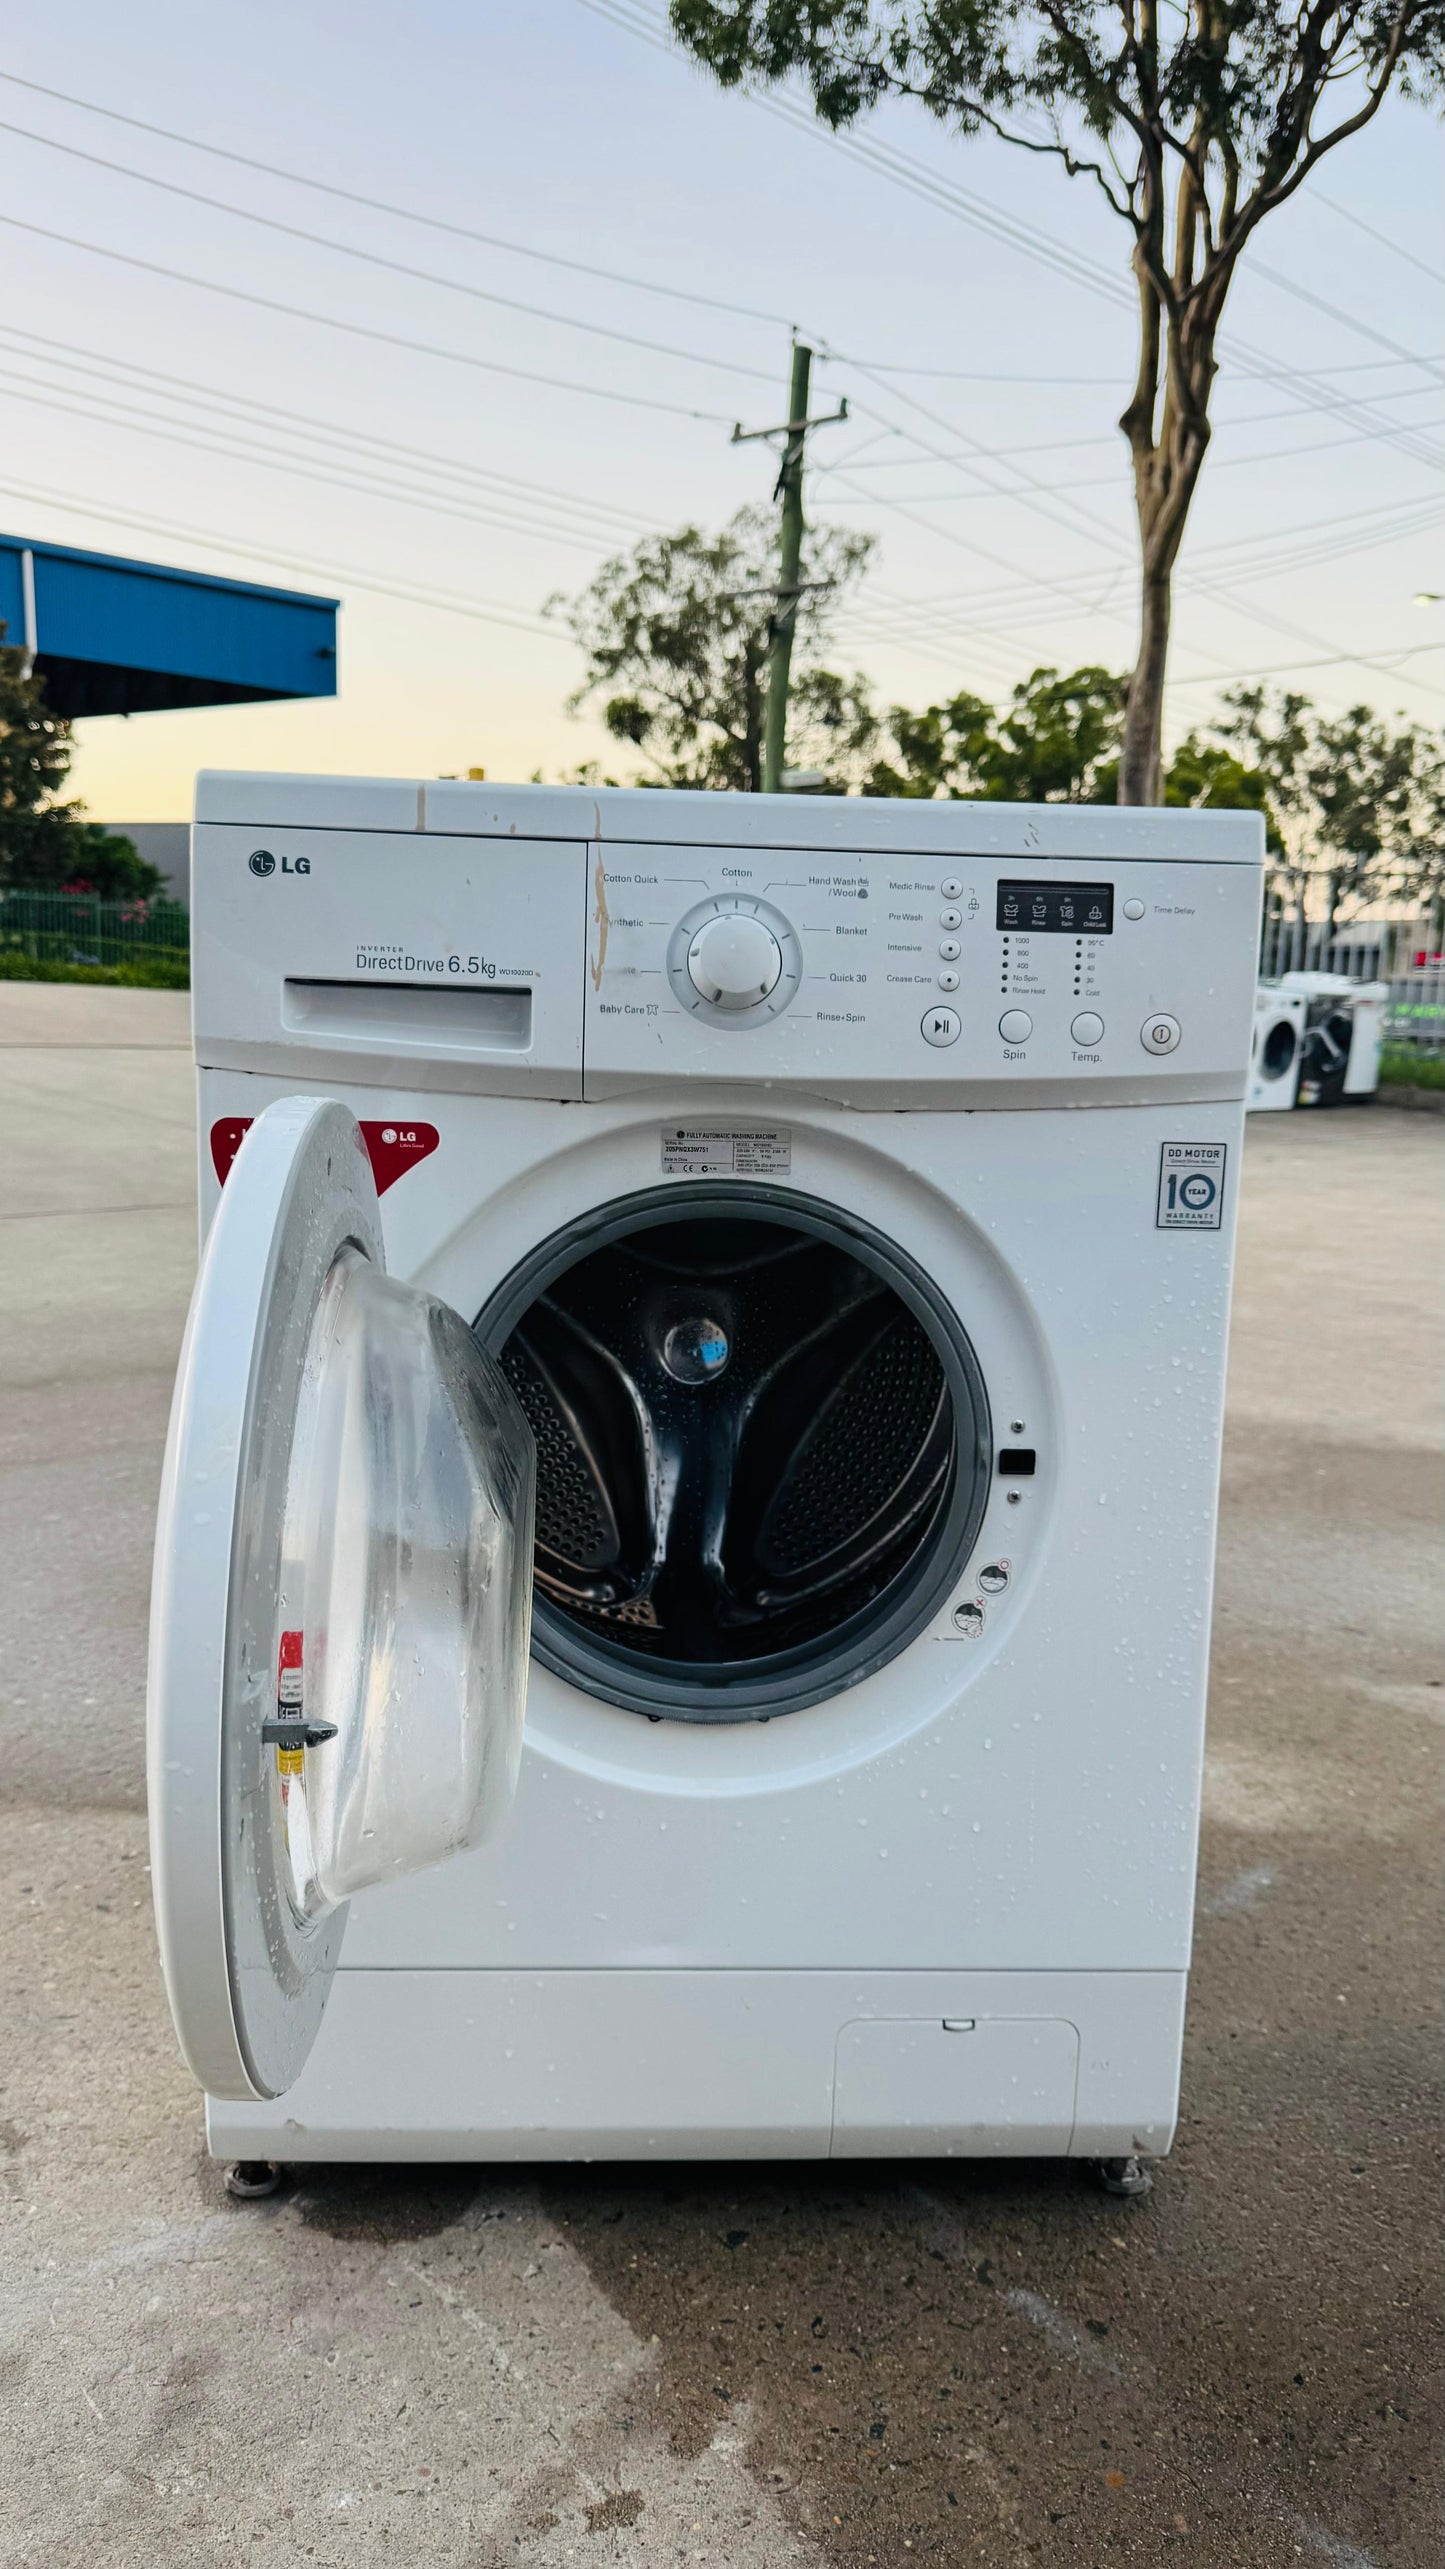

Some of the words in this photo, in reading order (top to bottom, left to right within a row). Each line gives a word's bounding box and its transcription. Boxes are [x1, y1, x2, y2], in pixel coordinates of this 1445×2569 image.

[281, 857, 311, 875] LG
[721, 867, 752, 878] Cotton
[603, 874, 633, 884] Cotton
[634, 874, 659, 886] Quick
[808, 875, 830, 886] Hand
[832, 877, 857, 887] Wash
[889, 882, 913, 890] Medic
[914, 883, 936, 891] Rinse
[1154, 905, 1172, 914] Time
[1174, 906, 1195, 915] Delay
[888, 912, 901, 921] Pre
[902, 913, 923, 921] Wash
[603, 917, 644, 927] ynthetic
[835, 926, 867, 936] Blanket
[356, 945, 404, 953] INVERTER
[887, 943, 922, 952] Intensive
[829, 972, 855, 984] Quick
[856, 973, 867, 983] 30
[886, 974, 913, 983] Crease
[914, 975, 932, 983] Care
[600, 1004, 622, 1015] Baby
[624, 1005, 645, 1014] Care
[1003, 1049, 1026, 1061] Spin
[1072, 1051, 1103, 1064] Temp.
[399, 1131, 417, 1142] LG
[1168, 1149, 1181, 1157] DD
[1185, 1150, 1219, 1158] MOTOR
